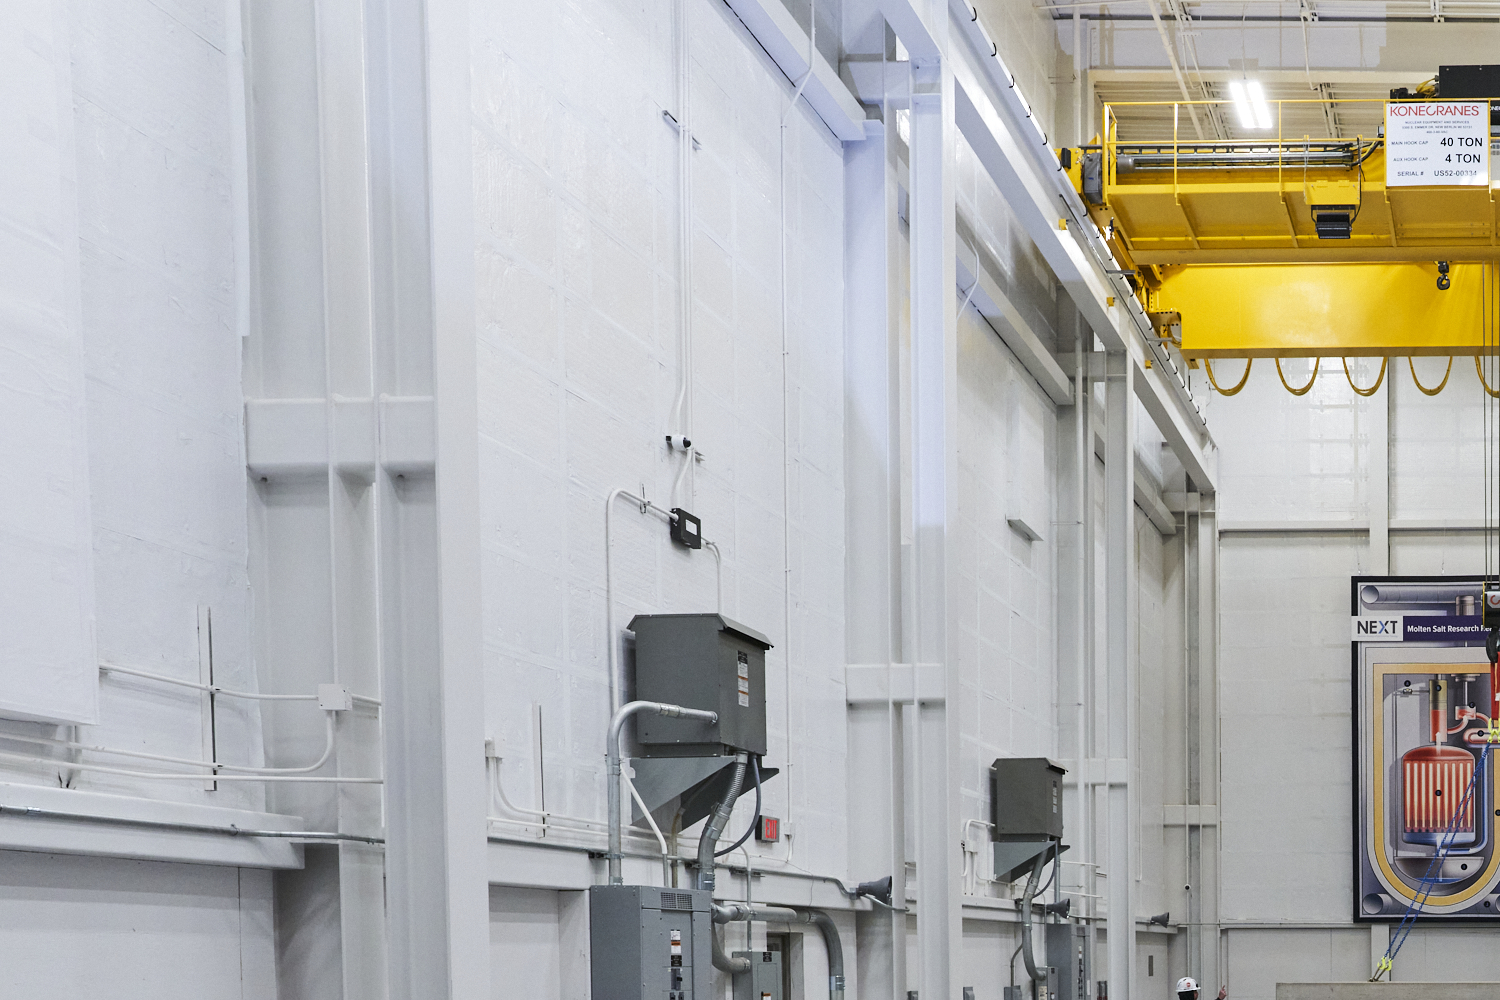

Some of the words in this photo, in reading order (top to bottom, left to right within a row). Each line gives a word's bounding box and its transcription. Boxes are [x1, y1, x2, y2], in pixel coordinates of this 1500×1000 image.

[1390, 106, 1480, 117] KONECRANES
[1440, 137, 1454, 147] 40
[1458, 137, 1483, 147] TON
[1445, 154, 1451, 163] 4
[1456, 154, 1481, 163] TON
[1357, 621, 1398, 634] NEXT
[1407, 625, 1431, 633] Molten
[765, 818, 777, 839] EXIT
